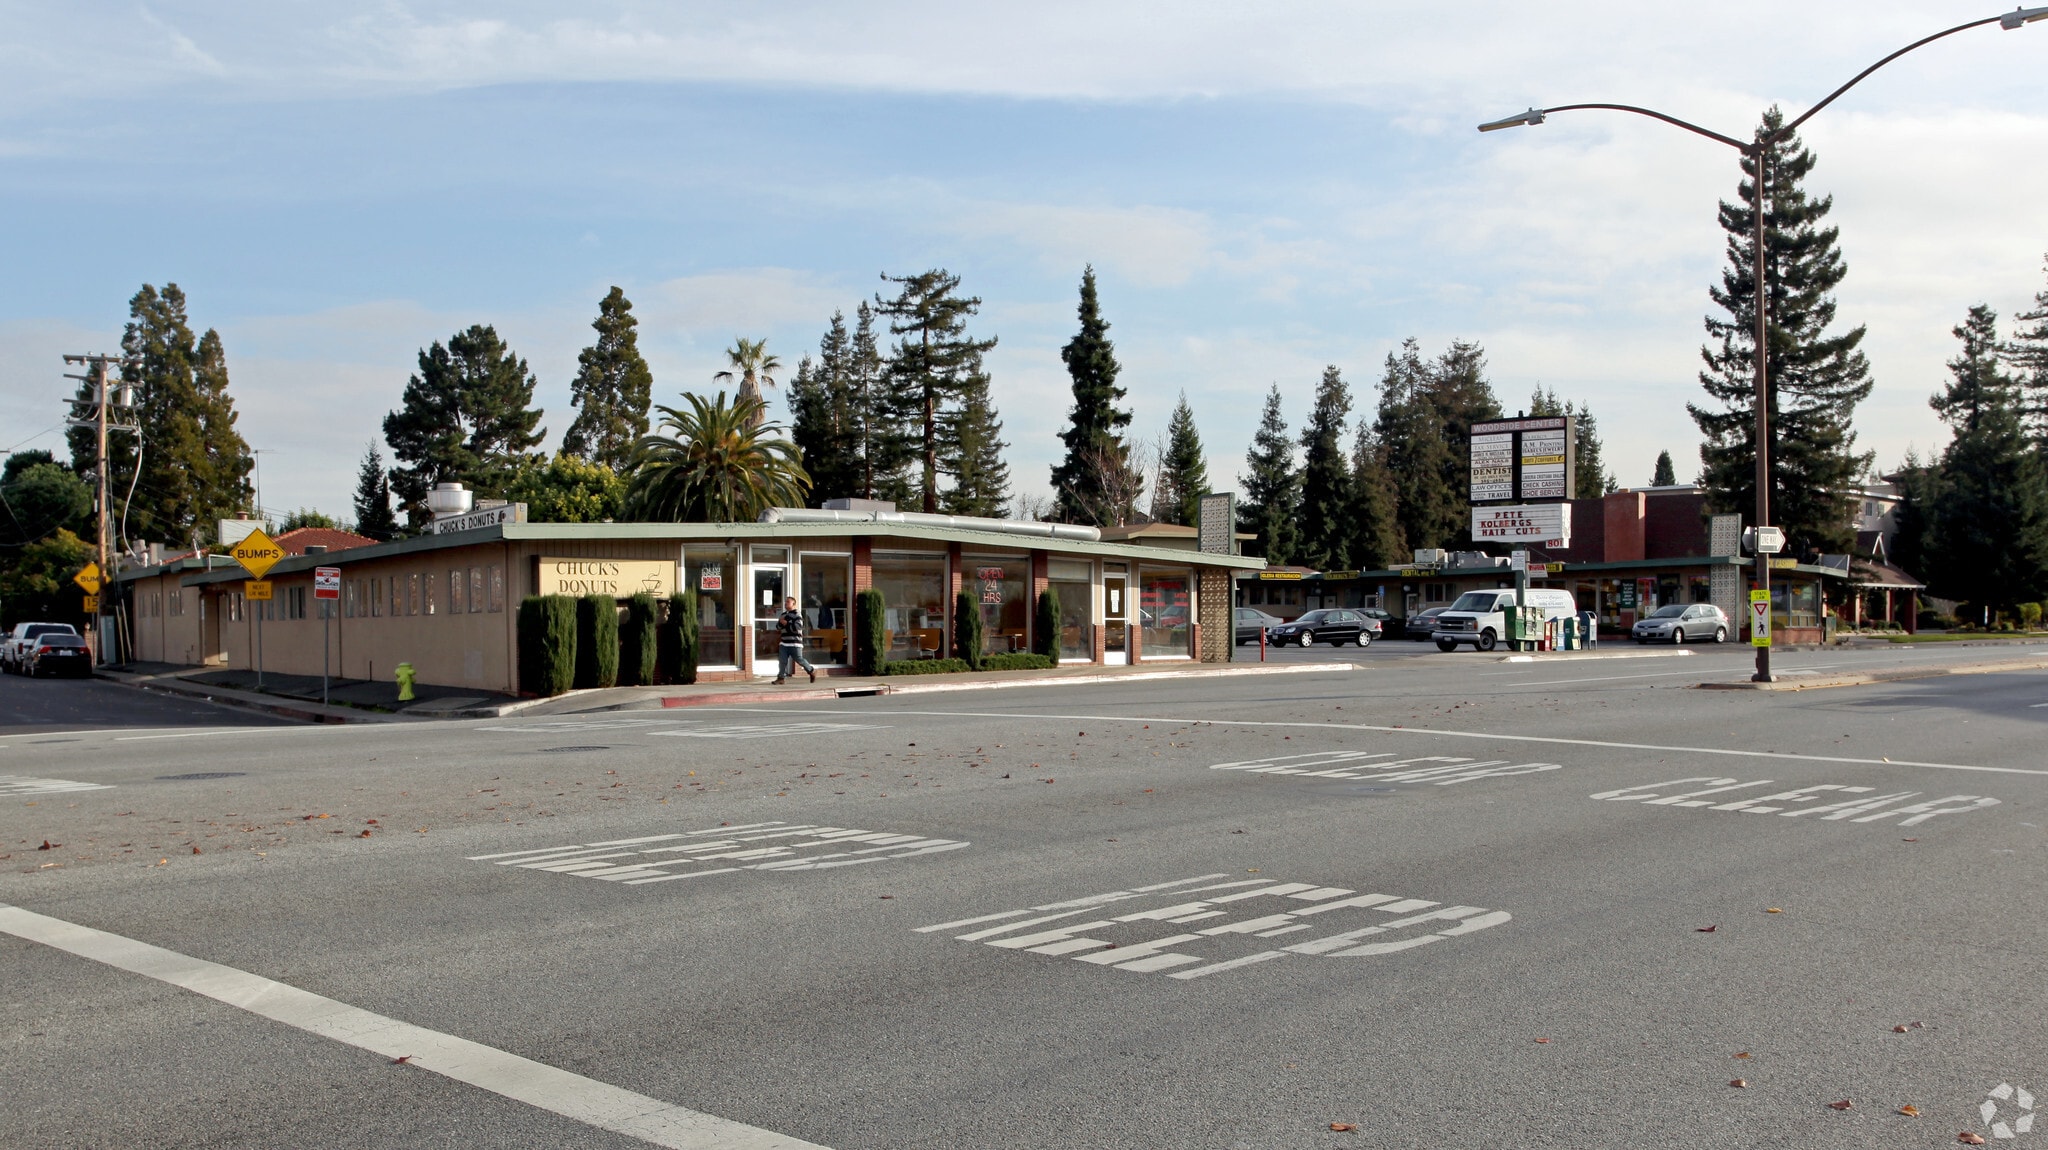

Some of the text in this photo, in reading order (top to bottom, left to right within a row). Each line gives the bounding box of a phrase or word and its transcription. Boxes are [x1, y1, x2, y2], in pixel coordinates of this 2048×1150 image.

[1473, 419, 1561, 432] WOODSIDE CENTER
[1473, 467, 1512, 476] DENTIST
[1540, 488, 1564, 496] SERVICE
[1495, 511, 1524, 519] PETE
[439, 511, 495, 534] CHUCK'S DONUTS
[1480, 519, 1532, 528] KOLBERGS
[1482, 526, 1541, 537] HAIR CUTS
[237, 549, 279, 559] BUMPS
[556, 561, 619, 576] CHUCK'S
[978, 567, 1004, 580] OPEN
[1401, 569, 1420, 577] DENTAL
[559, 579, 618, 594] DONUTS
[985, 579, 998, 592] 24
[983, 591, 1002, 603] HRS
[1209, 750, 1562, 785] CLEAR
[1589, 776, 2002, 826] CLEAR
[465, 821, 971, 885] KEEP
[911, 873, 1514, 979] KEEP
